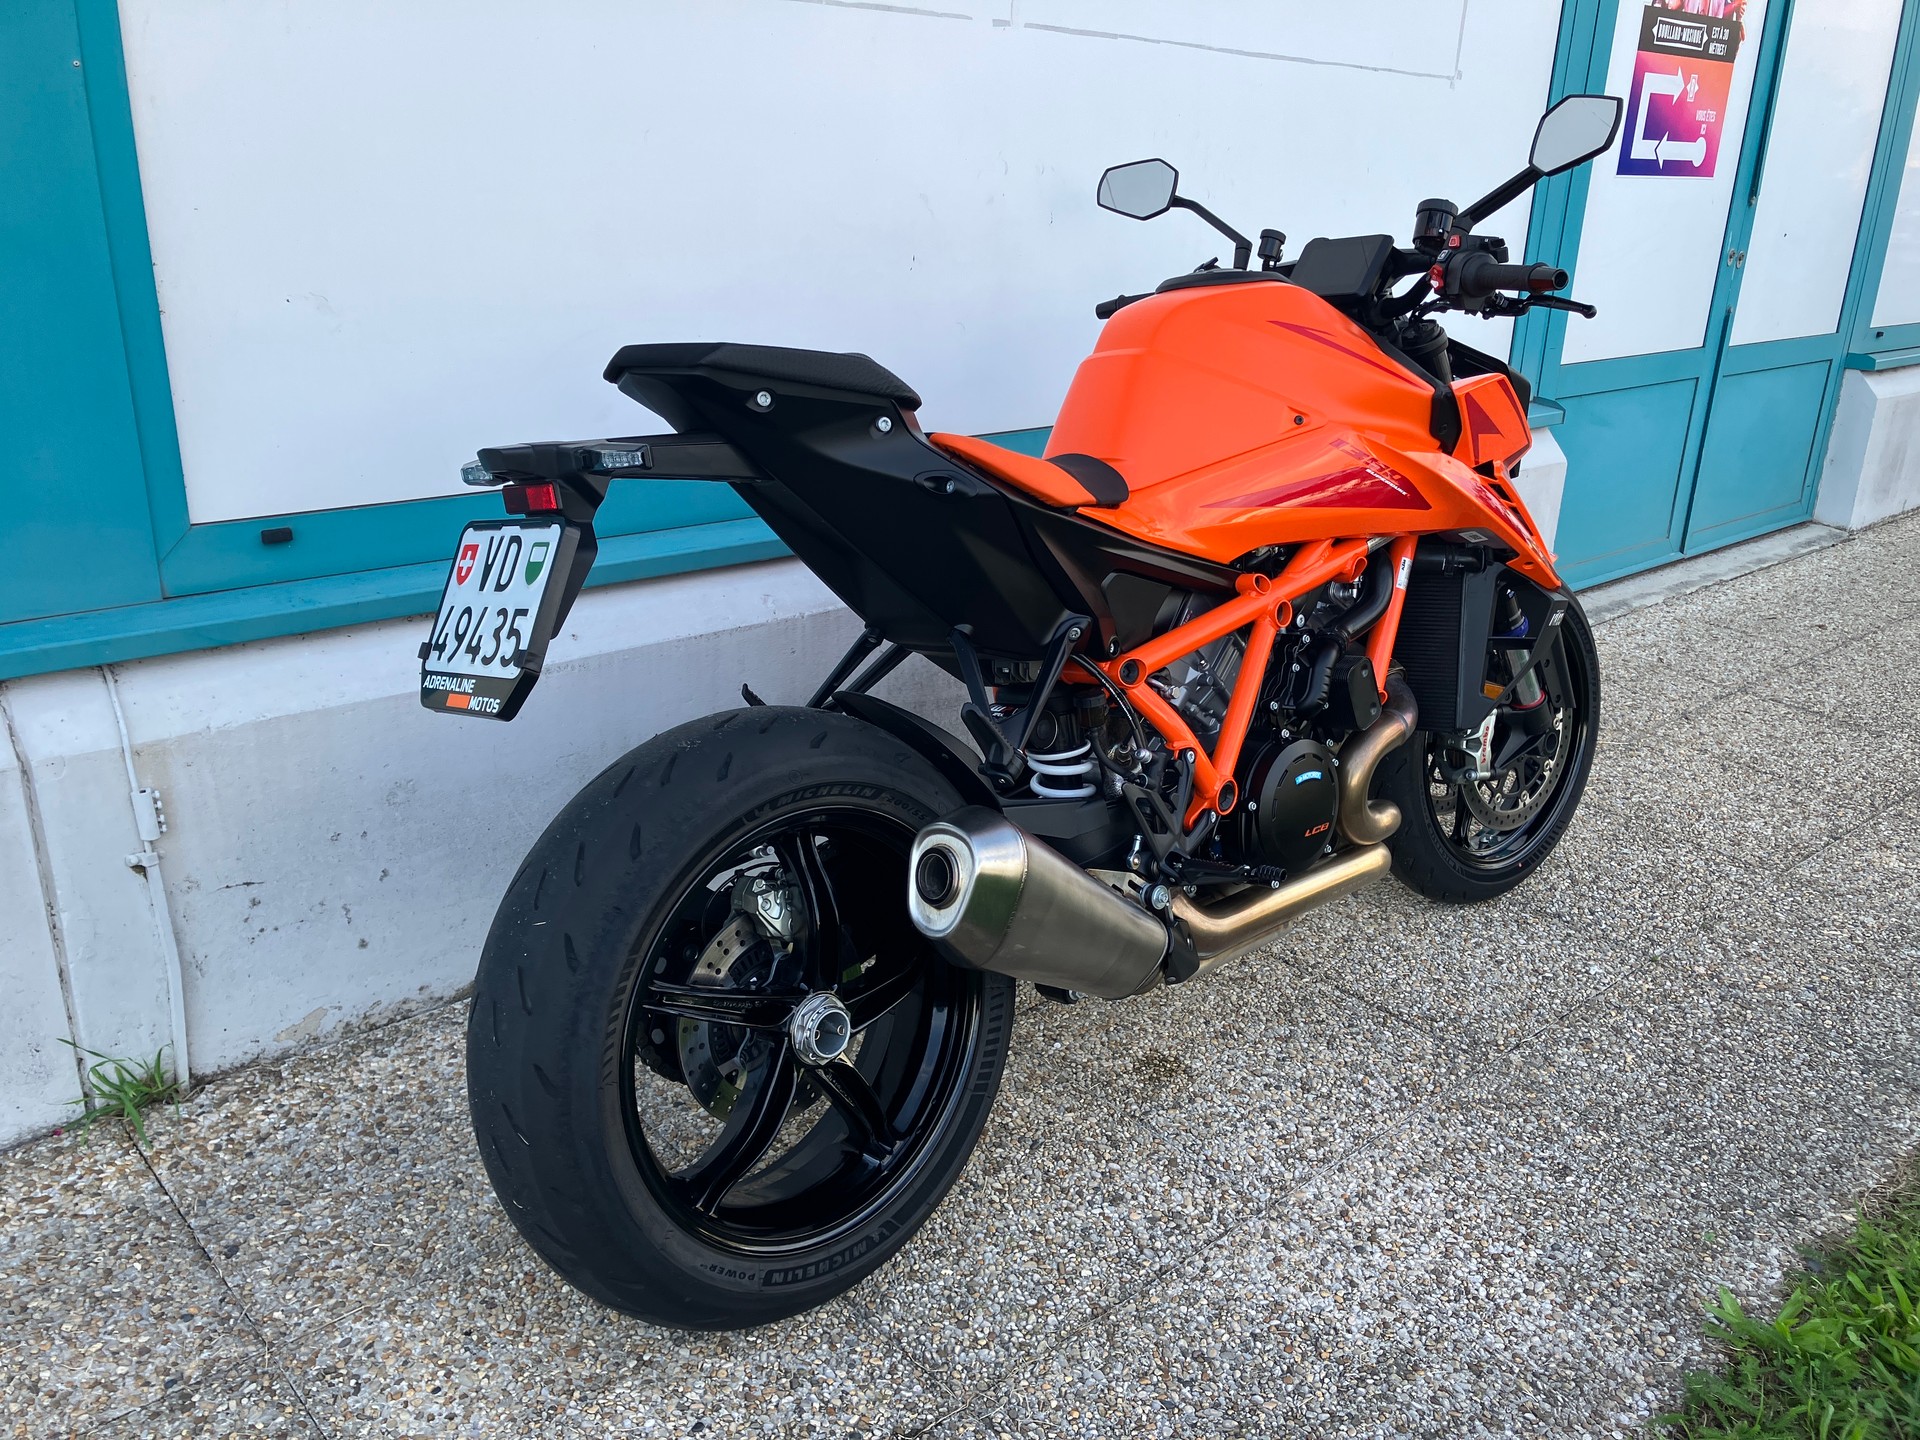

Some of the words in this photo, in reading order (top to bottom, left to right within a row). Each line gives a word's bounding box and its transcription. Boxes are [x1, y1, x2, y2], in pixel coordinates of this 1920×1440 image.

[1712, 27, 1721, 39] EST
[1723, 28, 1730, 40] 30
[1696, 109, 1707, 121] VOUS
[478, 535, 522, 592] VD
[432, 605, 529, 668] 49435
[423, 675, 476, 693] ADRENALINE
[468, 696, 501, 713] MOTOS
[1480, 725, 1490, 764] brembo
[776, 784, 877, 808] MICHELIN
[886, 795, 928, 821] 200/55
[1304, 822, 1330, 837] LC8
[770, 1240, 868, 1284] MICHELIN
[708, 1263, 756, 1281] POWER
